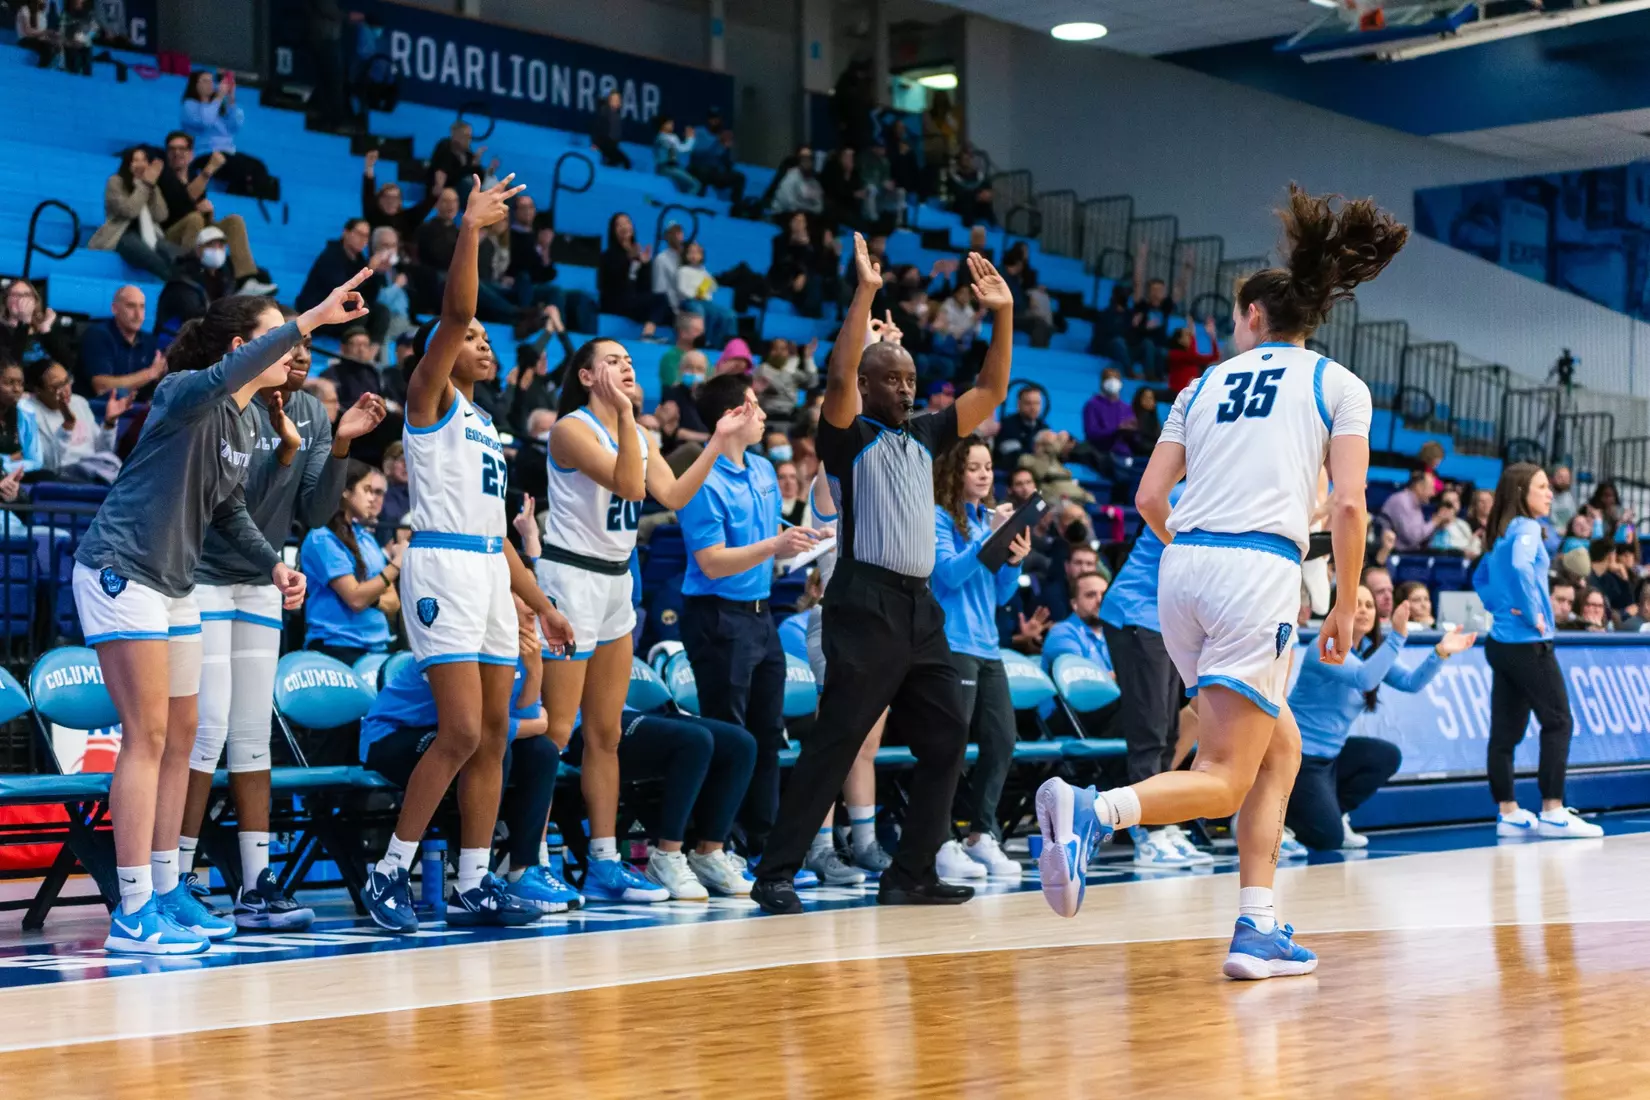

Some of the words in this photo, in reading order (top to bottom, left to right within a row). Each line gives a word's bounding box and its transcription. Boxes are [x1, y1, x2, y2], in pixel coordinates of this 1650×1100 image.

[390, 30, 484, 91] ROAR
[491, 51, 571, 109] LION
[1216, 367, 1287, 424] 35
[606, 493, 642, 531] 20
[284, 668, 359, 692] COLUMBIA
[1570, 664, 1650, 736] GOUR
